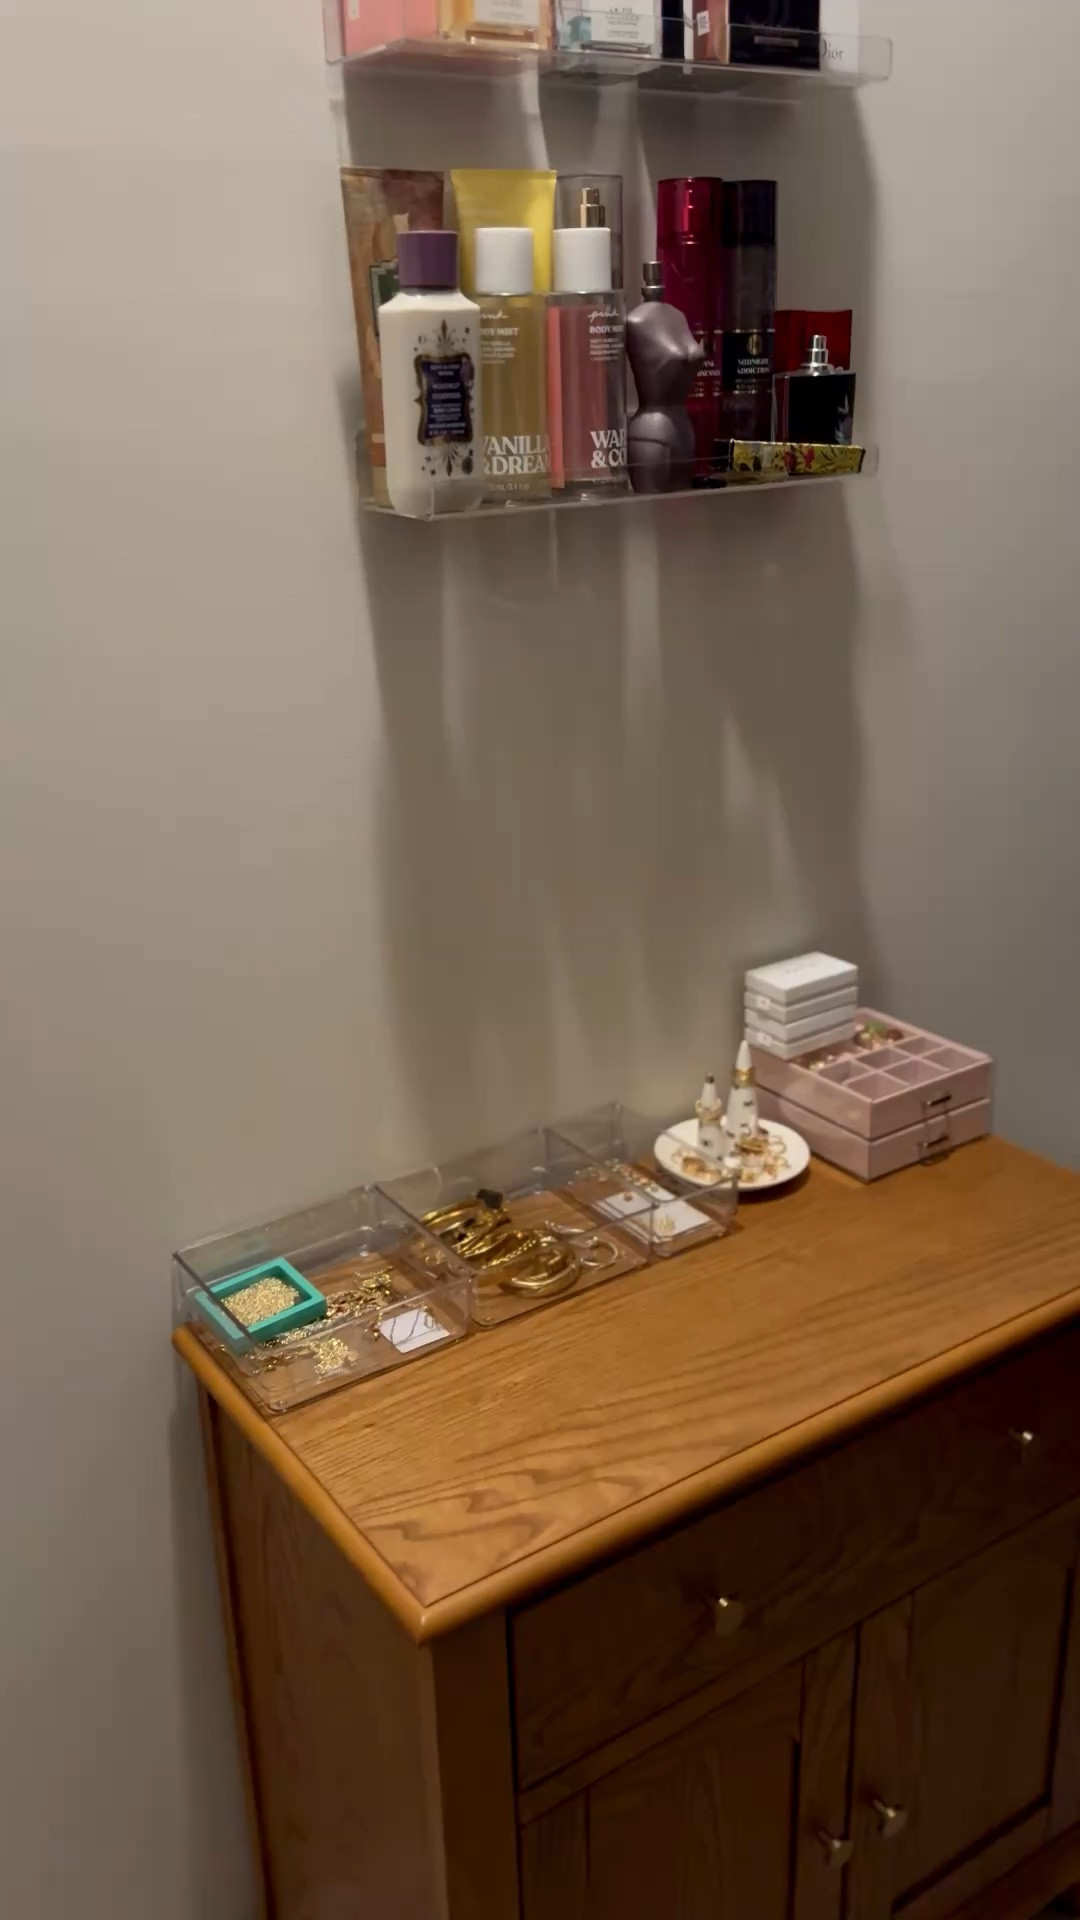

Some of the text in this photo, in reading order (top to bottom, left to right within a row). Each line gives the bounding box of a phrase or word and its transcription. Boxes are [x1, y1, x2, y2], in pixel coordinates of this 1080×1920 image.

[480, 309, 510, 320] ink
[497, 327, 520, 336] MIST
[589, 325, 612, 334] BODY
[737, 358, 769, 366] MIDNIGHT
[483, 434, 549, 455] ANILL
[492, 454, 550, 475] DREA
[591, 450, 607, 469] &
